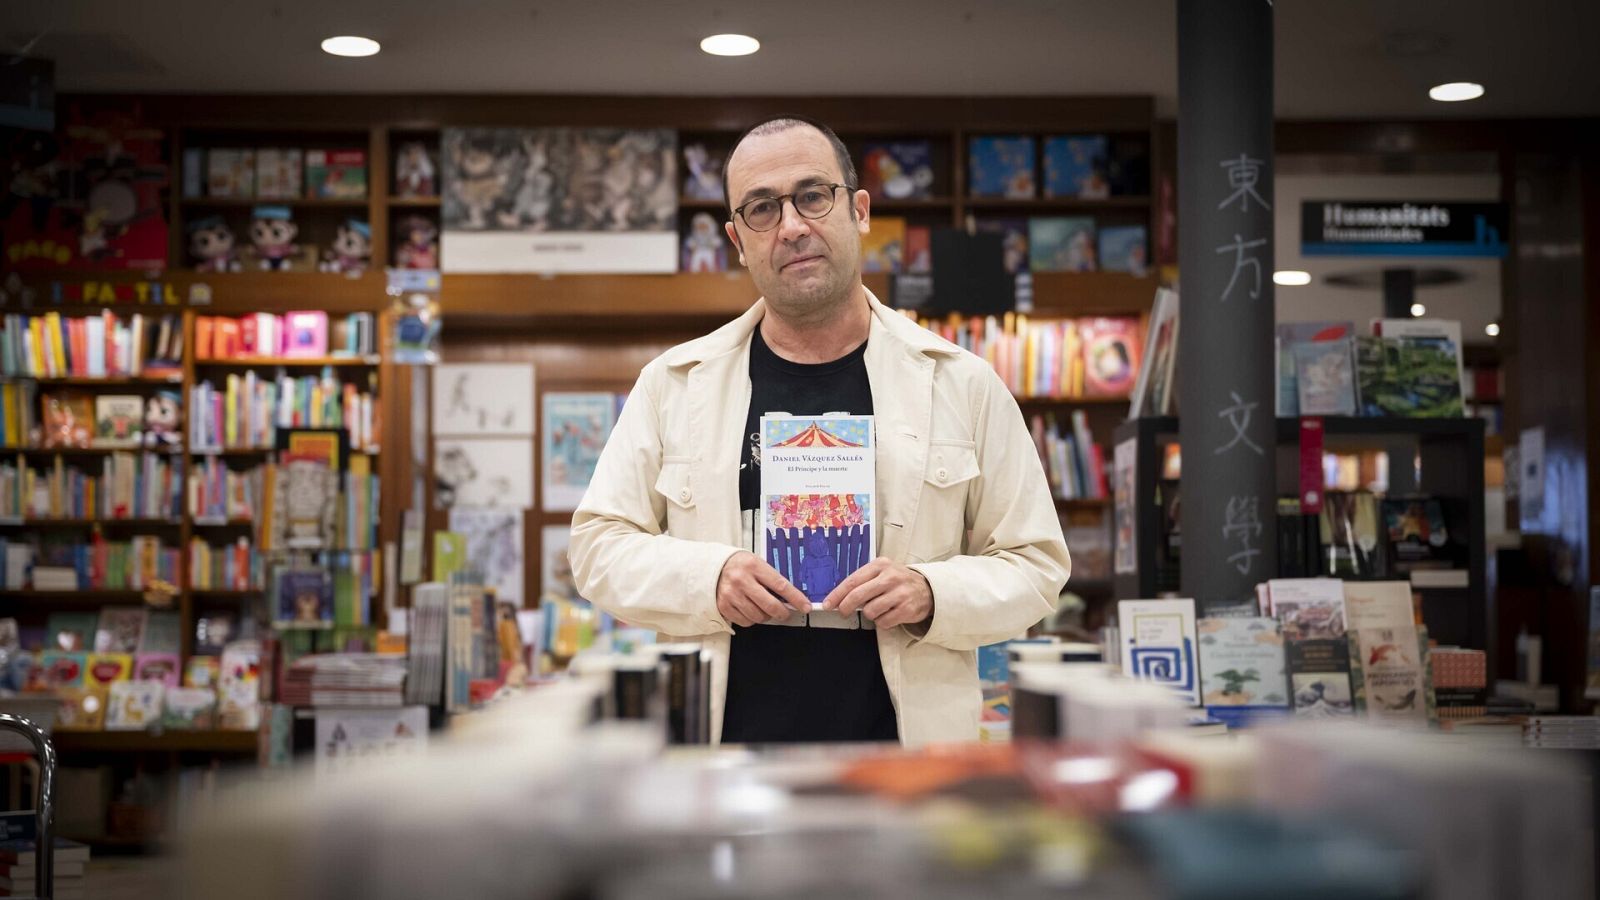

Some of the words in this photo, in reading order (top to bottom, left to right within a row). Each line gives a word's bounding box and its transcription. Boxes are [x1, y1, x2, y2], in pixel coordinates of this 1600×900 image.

[1323, 203, 1450, 227] Humanitats
[1323, 227, 1425, 242] Humanidades
[51, 280, 179, 305] INFANTIL
[772, 455, 801, 463] DANIEL
[802, 454, 835, 464] VÁZQUEZ
[837, 454, 863, 462] SALLÉS
